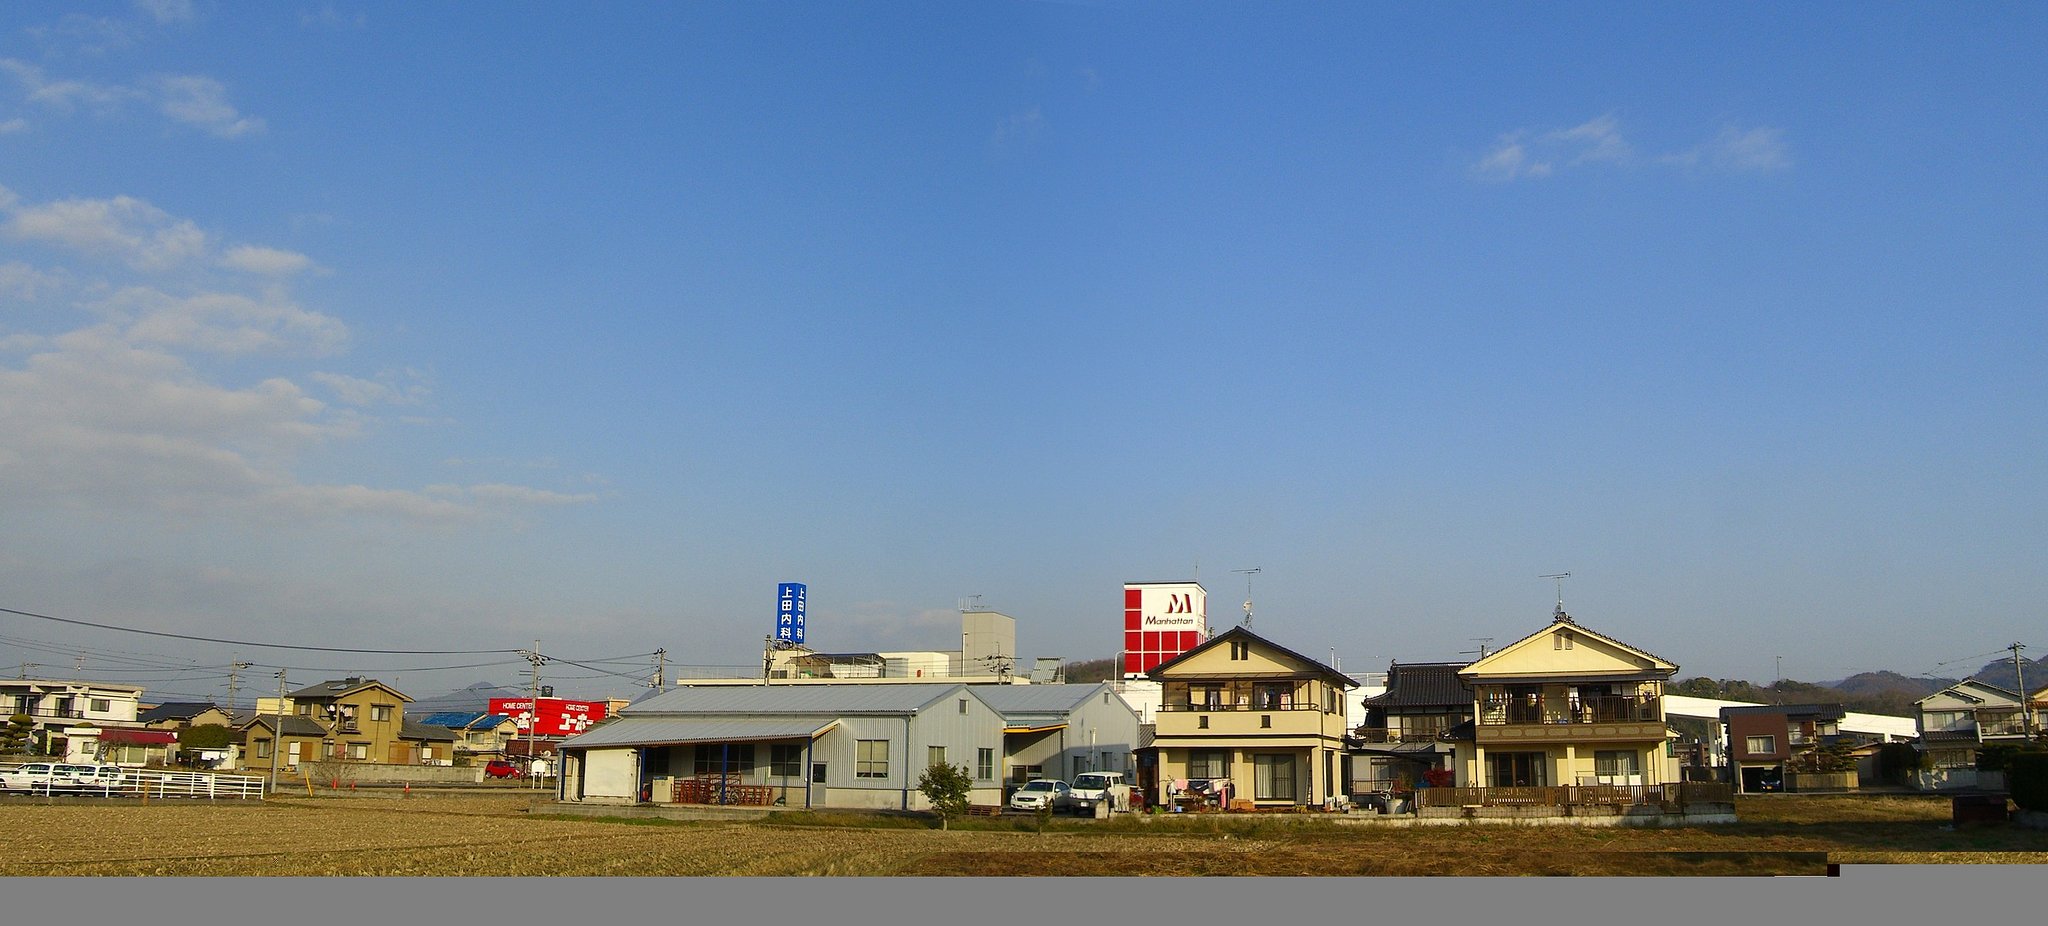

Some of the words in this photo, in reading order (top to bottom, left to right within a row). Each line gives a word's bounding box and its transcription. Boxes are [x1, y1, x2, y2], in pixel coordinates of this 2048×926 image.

[780, 586, 792, 638] 上田内科
[1145, 615, 1194, 625] Manhattan
[502, 702, 517, 710] HOME
[576, 704, 589, 712] CENTER
[559, 713, 594, 730] ユーホー
